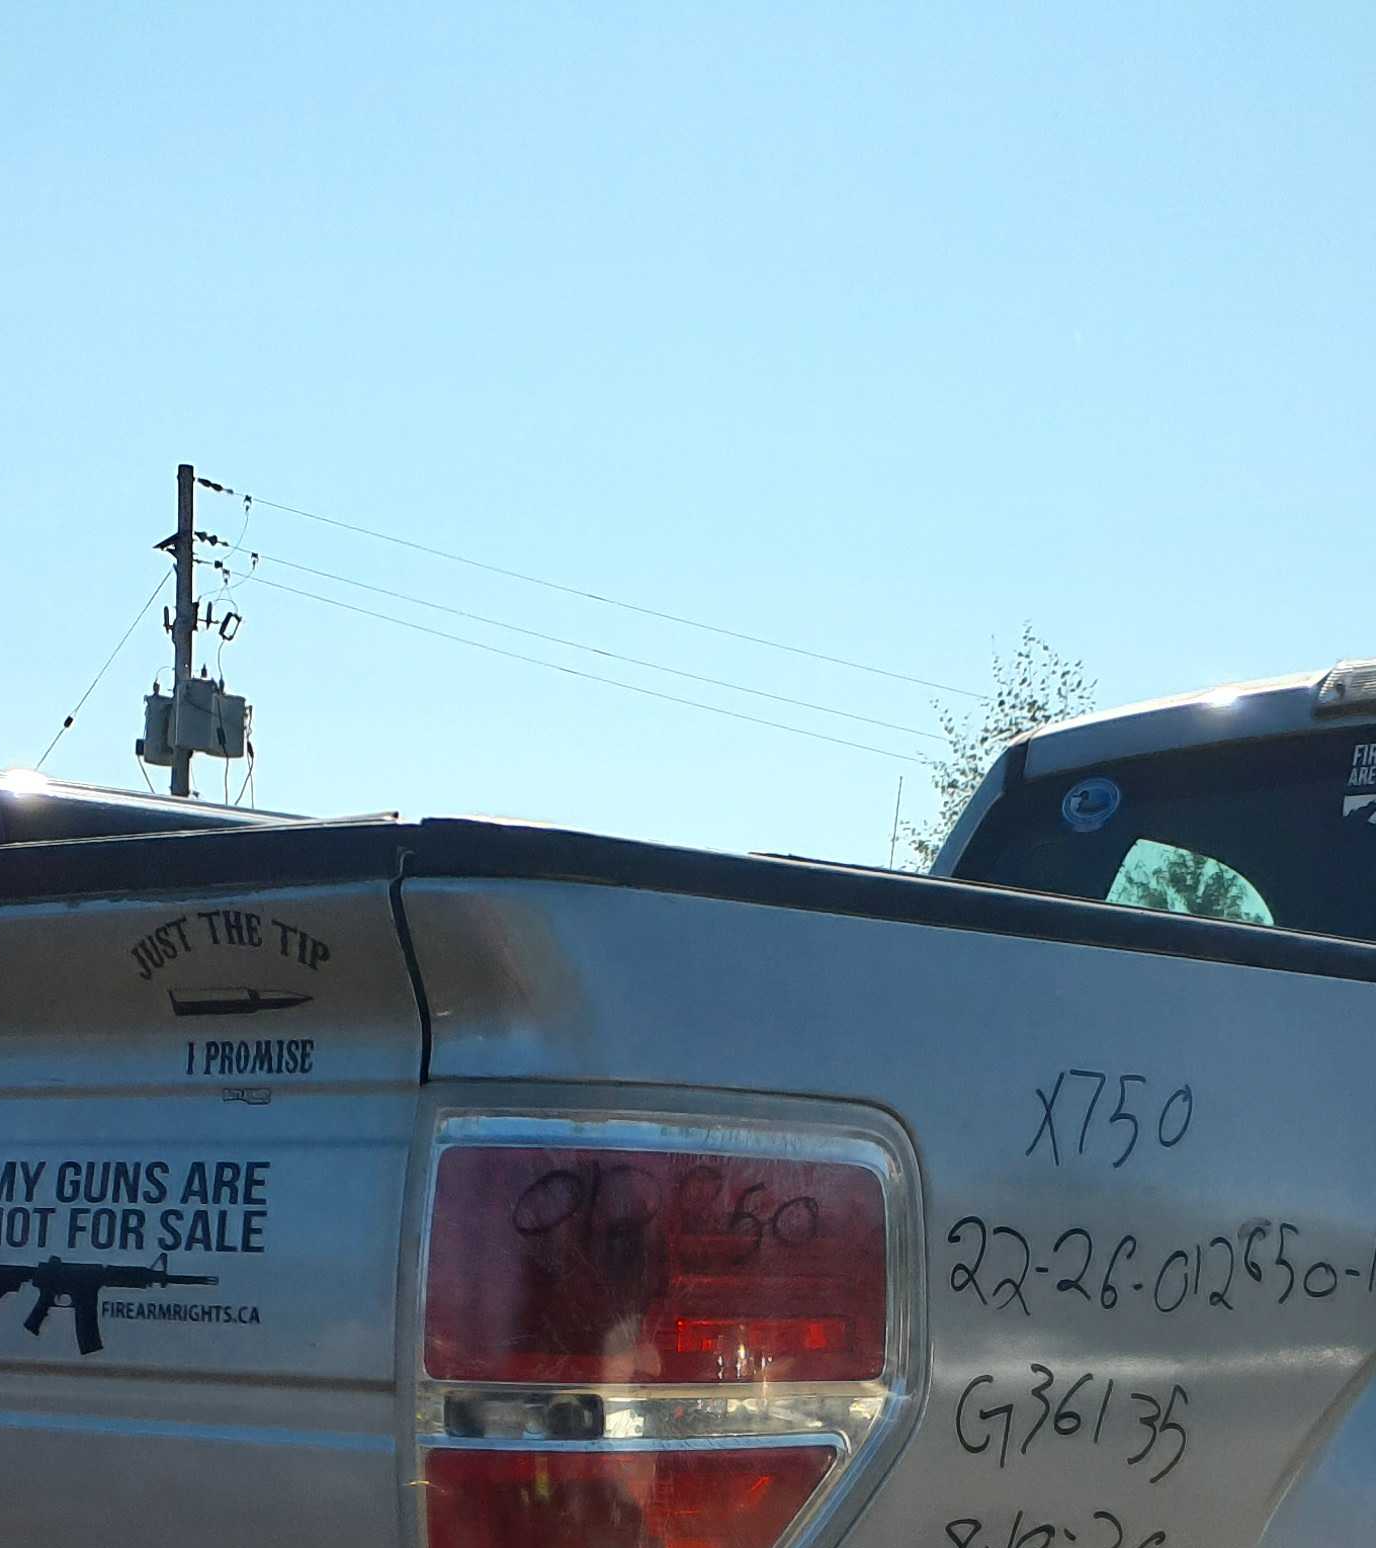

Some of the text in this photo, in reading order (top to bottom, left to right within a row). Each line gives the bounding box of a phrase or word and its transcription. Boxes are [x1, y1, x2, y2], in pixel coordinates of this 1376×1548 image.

[1347, 766, 1376, 786] ARE
[131, 910, 331, 980] JUST THE TIP
[186, 1039, 314, 1075] I PROMISE
[1025, 1068, 1194, 1168] X750
[55, 1161, 170, 1203] GUNS
[180, 1161, 271, 1205] ARE
[67, 1207, 146, 1250] FOR
[157, 1208, 268, 1253] SALE
[101, 1301, 261, 1325] FIREARMRIGHTS.CA
